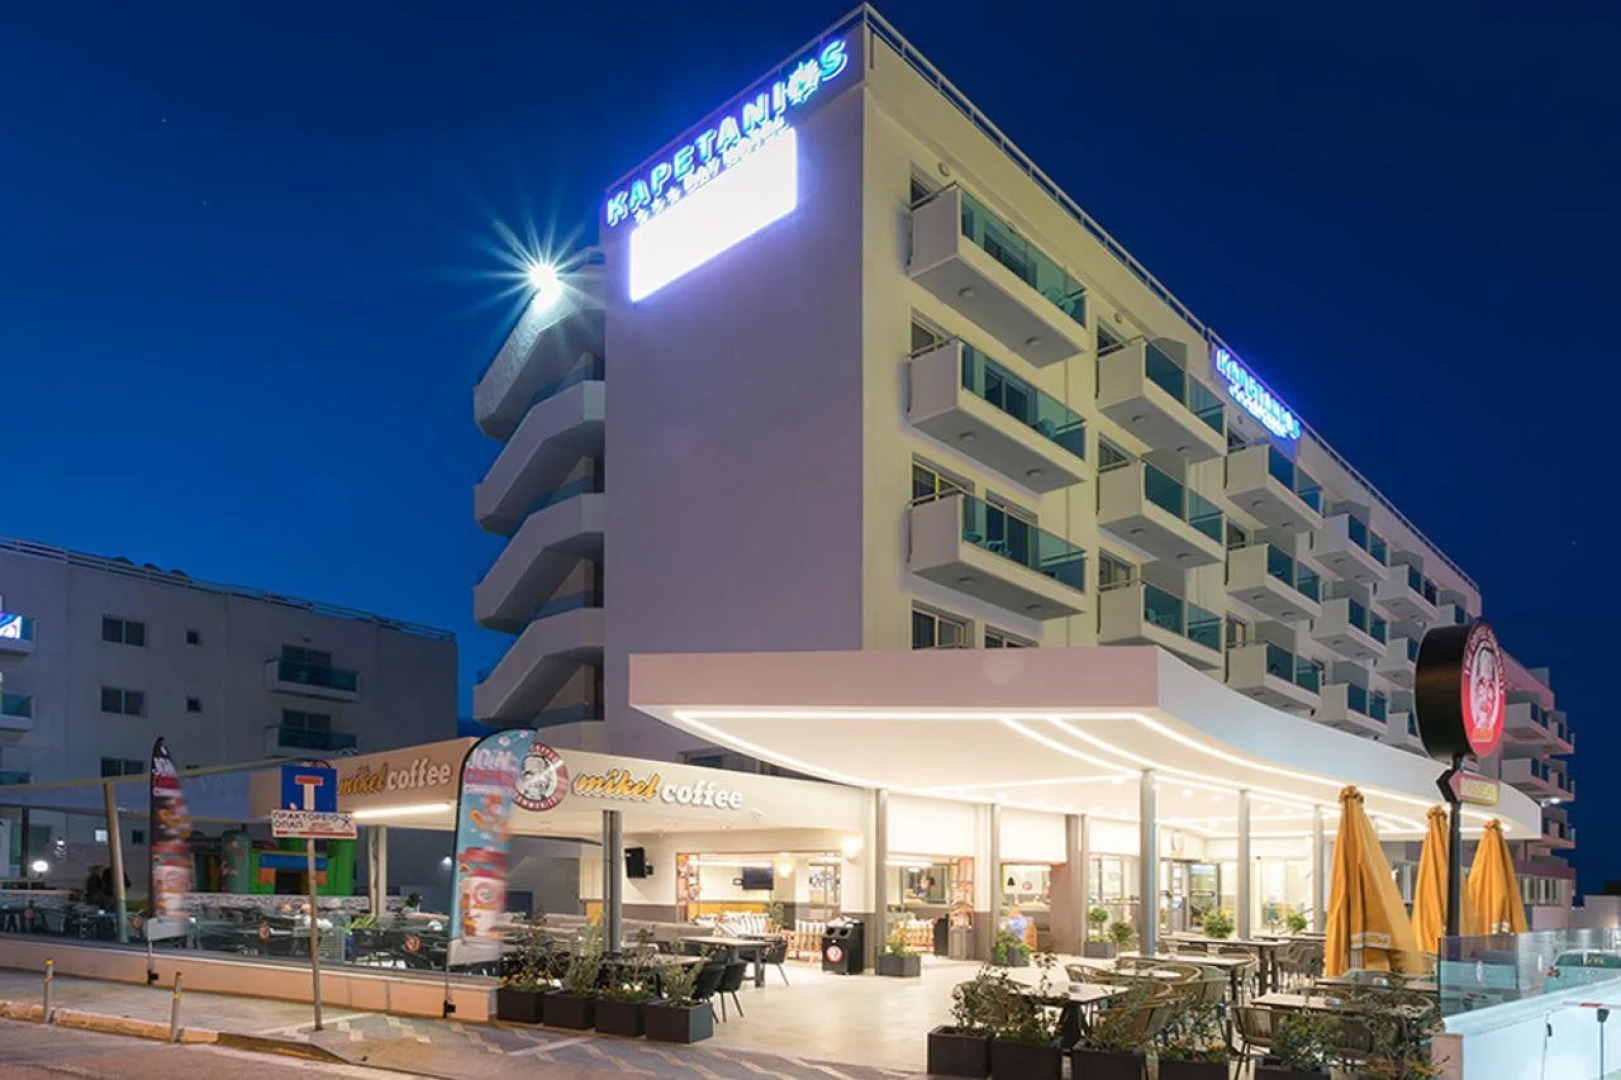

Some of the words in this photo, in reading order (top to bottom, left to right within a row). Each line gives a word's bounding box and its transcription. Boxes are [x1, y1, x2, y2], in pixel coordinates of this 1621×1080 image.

[606, 39, 848, 227] KAPETANIOS
[386, 757, 452, 791] coffee
[573, 767, 662, 801] mikel
[660, 780, 743, 810] coffee
